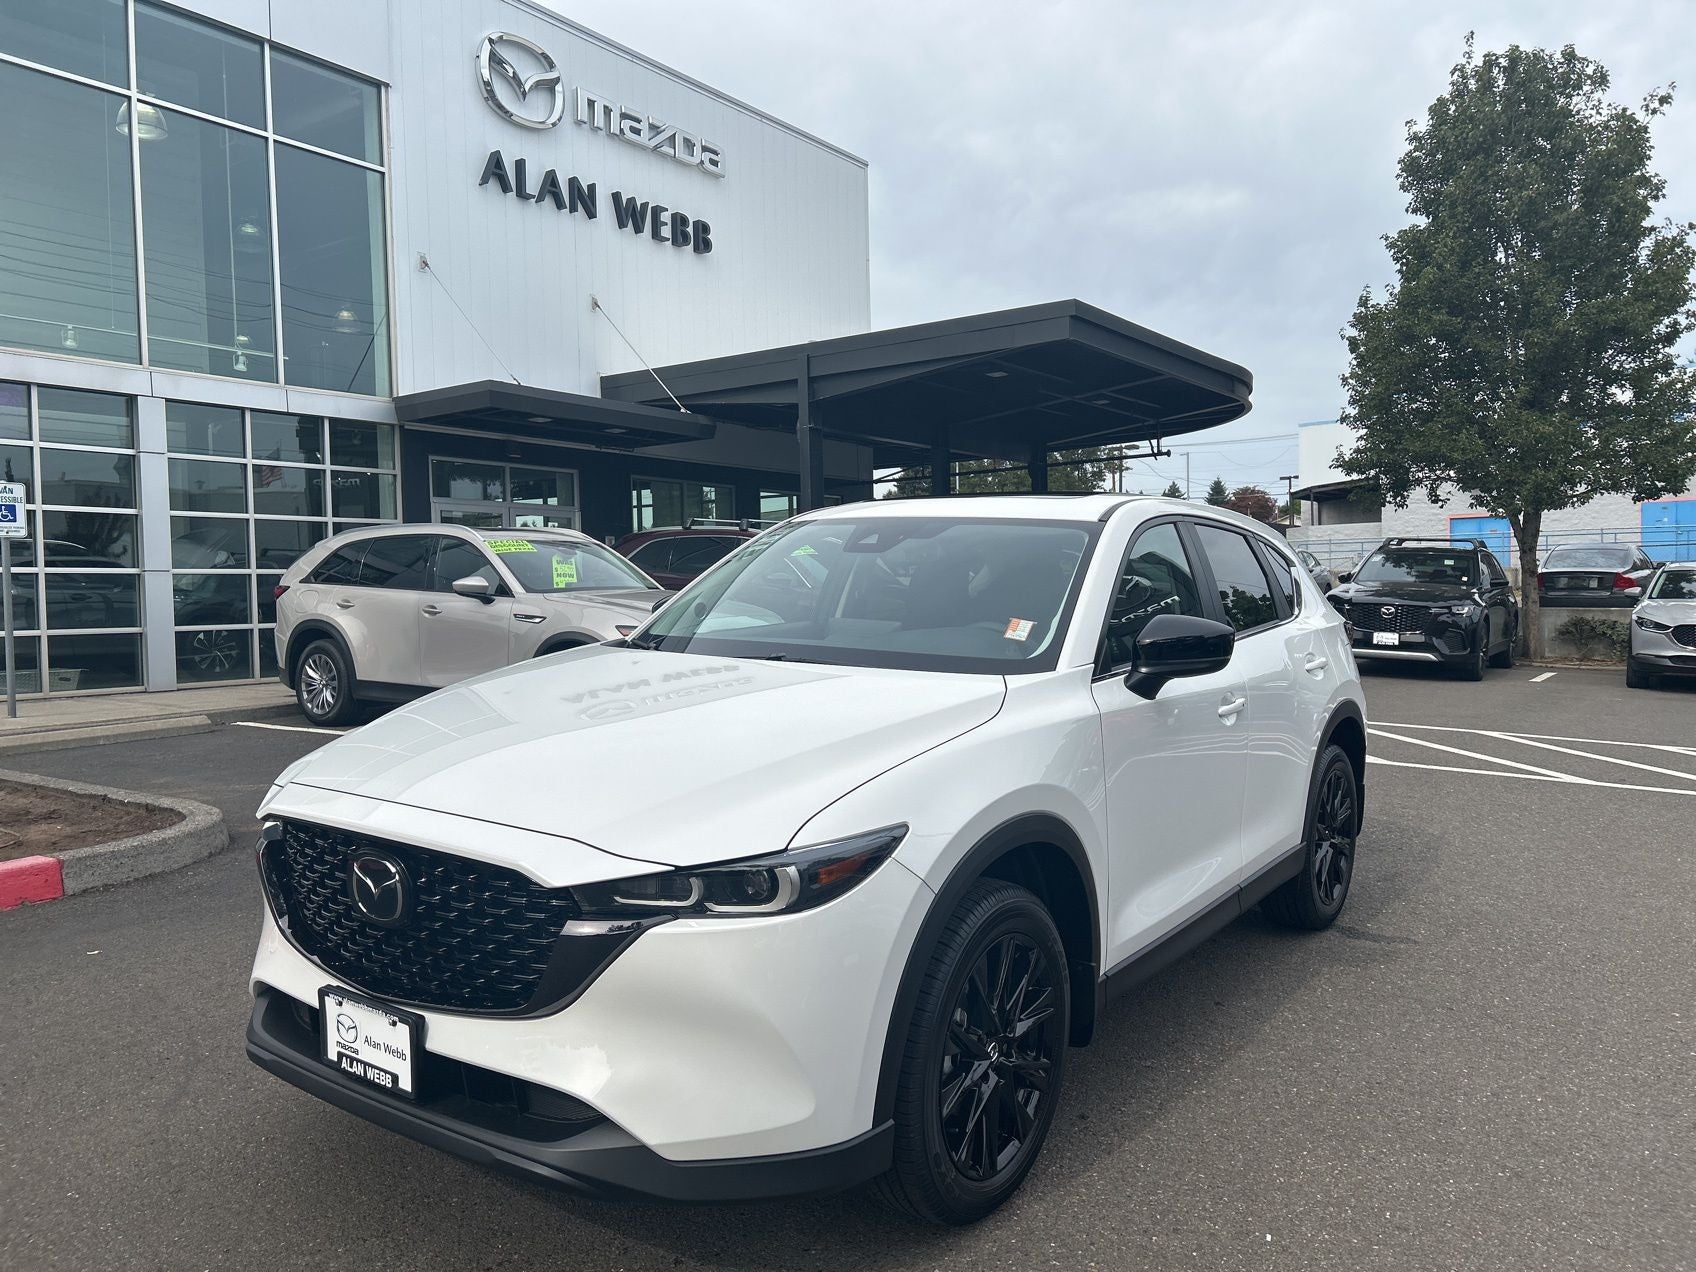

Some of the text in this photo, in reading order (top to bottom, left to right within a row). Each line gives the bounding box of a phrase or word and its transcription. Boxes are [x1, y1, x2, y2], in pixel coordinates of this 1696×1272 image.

[573, 86, 725, 178] mazda
[479, 150, 712, 255] ALAN WEBB
[336, 1041, 359, 1056] mazda
[363, 1035, 407, 1062] Alan Webb
[341, 1057, 393, 1088] ALAN WEBB
